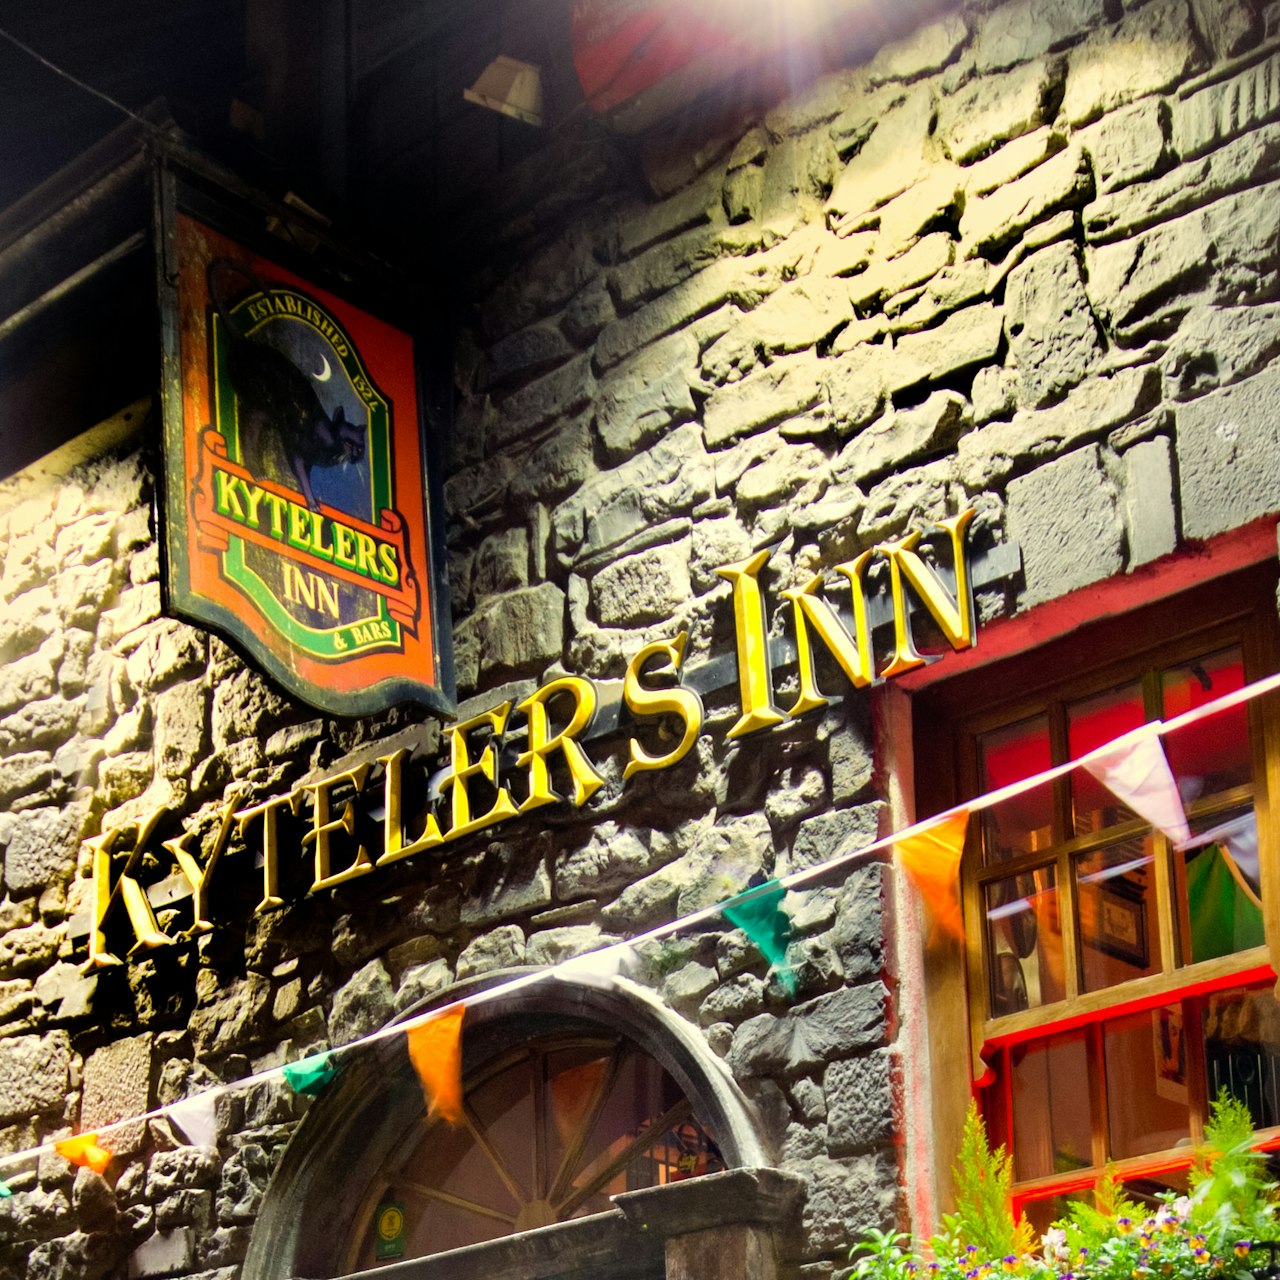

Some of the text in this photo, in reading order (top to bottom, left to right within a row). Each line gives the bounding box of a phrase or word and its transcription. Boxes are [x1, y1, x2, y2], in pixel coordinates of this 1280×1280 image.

[249, 295, 349, 358] ESTABLISHED
[216, 470, 401, 585] KYTELERS
[281, 563, 340, 619] INN
[333, 622, 391, 651] & BARS
[80, 507, 978, 976] KYTELERS INN
